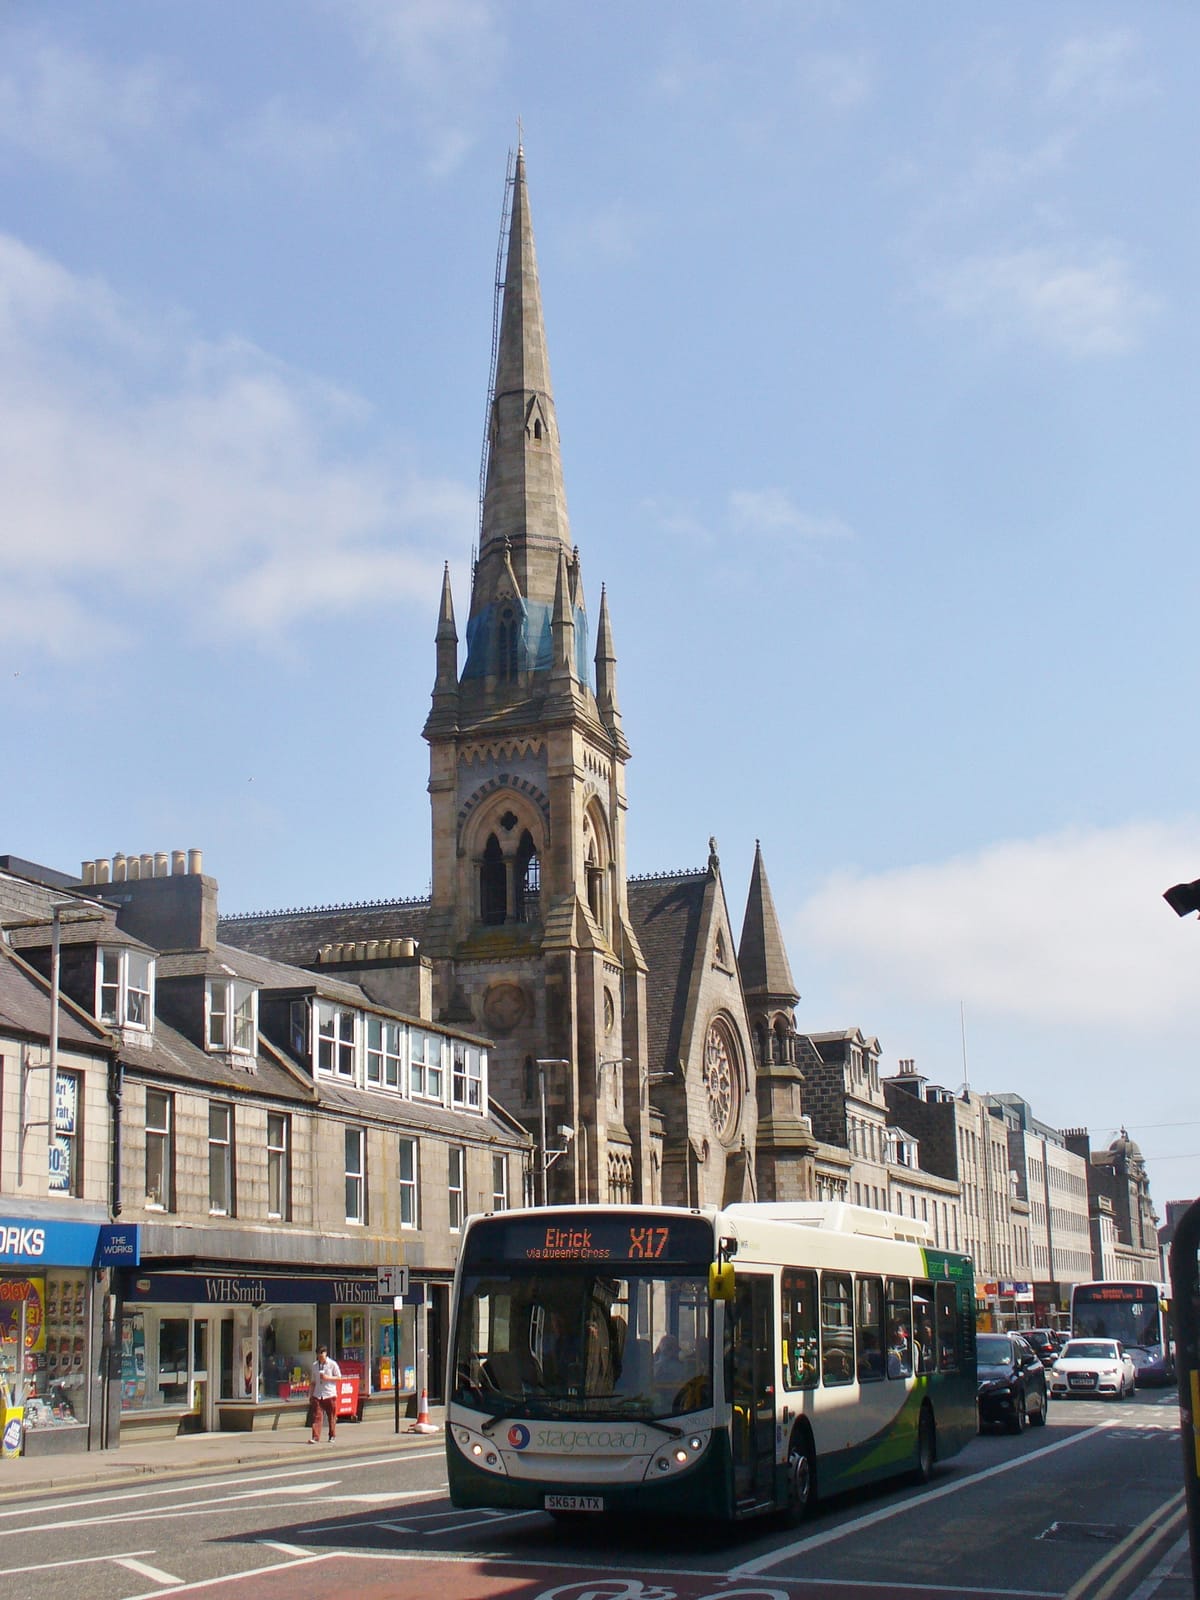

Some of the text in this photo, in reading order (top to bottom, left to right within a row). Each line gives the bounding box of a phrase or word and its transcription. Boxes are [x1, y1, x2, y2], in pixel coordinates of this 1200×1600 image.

[111, 1236, 126, 1245] THE
[545, 1227, 669, 1258] Elrick X17
[104, 1245, 133, 1254] WORKS
[526, 1248, 610, 1259] via Queen's Cross
[206, 1279, 266, 1302] WHSmith
[537, 1428, 648, 1453] stagecoach
[549, 1497, 600, 1510] SK63 ATX
